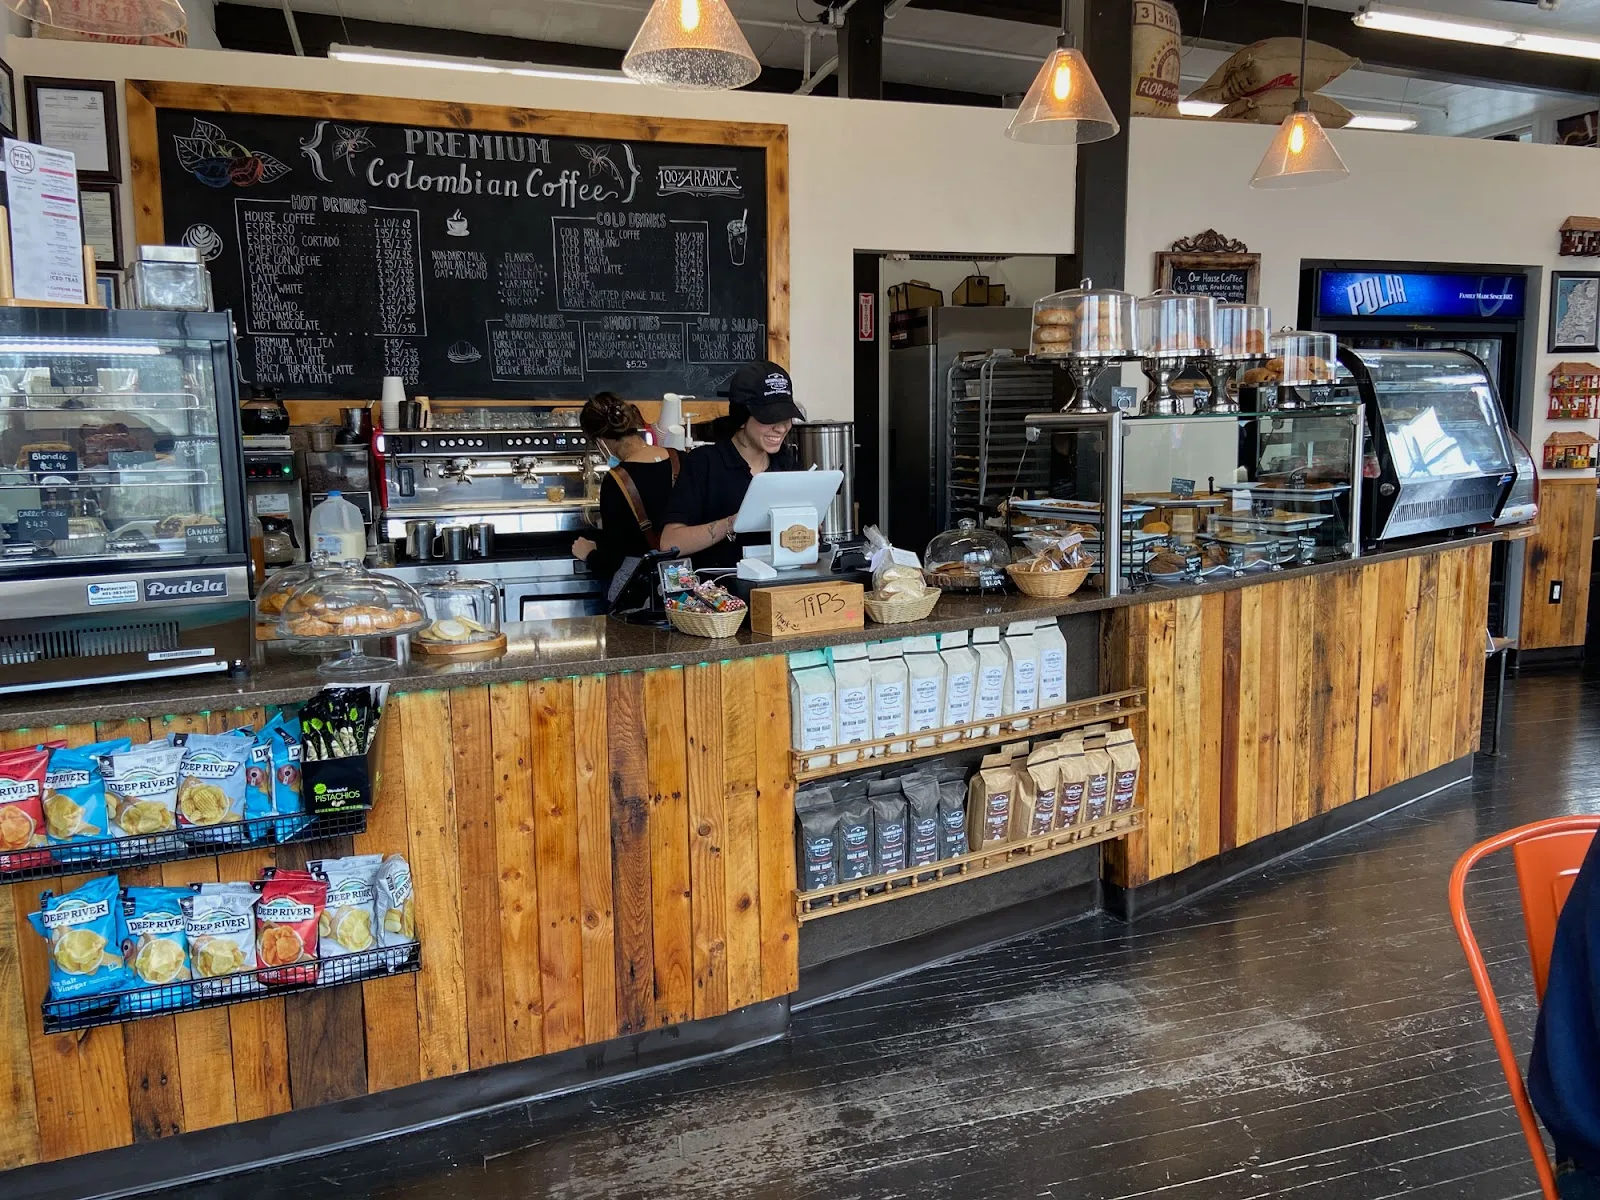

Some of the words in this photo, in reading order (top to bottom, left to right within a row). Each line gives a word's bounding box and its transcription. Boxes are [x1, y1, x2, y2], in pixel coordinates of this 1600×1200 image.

[1142, 8, 1149, 18] 3
[1140, 80, 1162, 96] FLOR
[404, 128, 552, 164] PREMIUM
[14, 152, 30, 160] MEM
[366, 160, 519, 198] Colombian
[525, 168, 619, 209] Coffee
[681, 170, 742, 189] ARABICA
[291, 194, 318, 210] HOT
[323, 196, 368, 214] DRINKS
[244, 211, 276, 223] HOUSE
[283, 213, 316, 225] COFFEE
[597, 212, 625, 227] COLD
[629, 213, 666, 228] DRINKS
[246, 223, 294, 234] ESPRESSO
[560, 228, 579, 238] COLD
[583, 228, 599, 238] BREW
[605, 230, 614, 239] ICE
[619, 230, 640, 240] COFFEE
[247, 235, 295, 245] ESPRESSO
[302, 236, 340, 247] CORTADO
[562, 237, 579, 247] ICED
[584, 238, 620, 247] AMERICANO
[247, 246, 299, 255] AMERICANO
[562, 246, 579, 256] ICED
[248, 255, 270, 264] CAFE
[296, 256, 322, 266] LECHE
[468, 251, 486, 262] MILK
[505, 252, 534, 262] FLAVORS
[562, 256, 579, 265] ICED
[584, 256, 610, 265] MOCHA
[249, 264, 304, 275] CAPPUCCINO
[434, 261, 471, 270] AVAILABLE
[504, 263, 539, 271] VANILLA
[604, 265, 623, 274] LATTE
[50, 275, 64, 283] ICED
[251, 274, 279, 284] LATTE
[435, 270, 449, 278] OAT
[455, 269, 487, 280] ALMOND
[504, 271, 543, 279] HAZELNUT
[1189, 272, 1200, 282] Our
[1203, 273, 1220, 282] House
[1221, 273, 1243, 282] Coffee
[251, 284, 272, 293] FLAT
[278, 284, 303, 294] WHITE
[505, 280, 537, 288] CARAMEL
[252, 293, 279, 302] MOCHA
[502, 288, 540, 297] COCONUT
[1347, 275, 1408, 315] POLAR
[507, 297, 533, 306] MOCHA
[252, 302, 298, 312] MACCHIATO
[253, 312, 305, 320] VIETNAMESE
[253, 321, 271, 330] HOT
[277, 321, 320, 331] CHOCOLATE
[505, 314, 565, 329] SANDWICHES
[602, 316, 660, 331] SMOOTHIES
[697, 317, 720, 332] SOUP
[732, 318, 758, 332] SALAD
[493, 331, 508, 339] HAM
[539, 332, 573, 341] CROISSANT
[588, 332, 615, 340] MANGO
[639, 333, 680, 342] BLACKBERRY
[692, 334, 710, 342] DAILY
[717, 334, 729, 342] HOT
[738, 334, 755, 343] SOUP
[255, 337, 289, 347] PREMIUM
[296, 338, 314, 347] HOT
[318, 339, 334, 348] TEA
[493, 340, 517, 348] TURKEY
[733, 342, 755, 351] SALAD
[299, 347, 322, 356] LATTE
[530, 349, 544, 357] HAM
[548, 350, 571, 358] BACON
[700, 351, 728, 359] GARDEN
[733, 351, 756, 360] SALAD
[256, 356, 272, 364] RED
[302, 356, 327, 364] LATTE
[256, 365, 279, 374] SPICY
[287, 365, 328, 374] TURMERIC
[332, 365, 354, 375] LATTE
[496, 366, 520, 375] DELUXE
[257, 374, 283, 383] MACHA
[289, 374, 304, 383] TEA
[310, 374, 333, 384] LATTE
[32, 453, 68, 461] Blondie
[146, 580, 224, 596] Padela
[179, 760, 202, 771] DEEP
[203, 763, 235, 773] RIVER
[109, 782, 138, 792] DEEP
[139, 776, 175, 789] RIVER
[315, 790, 360, 802] PISTACHIOS
[327, 893, 351, 903] DEEP
[44, 912, 71, 924] DEEP
[72, 904, 106, 918] RIVER
[258, 906, 279, 916] DEEP
[280, 908, 310, 916] RIVER
[129, 920, 154, 931] DEEP
[187, 921, 214, 933] DEEP
[214, 917, 246, 928] RIVER
[57, 981, 87, 992] Vinegar
